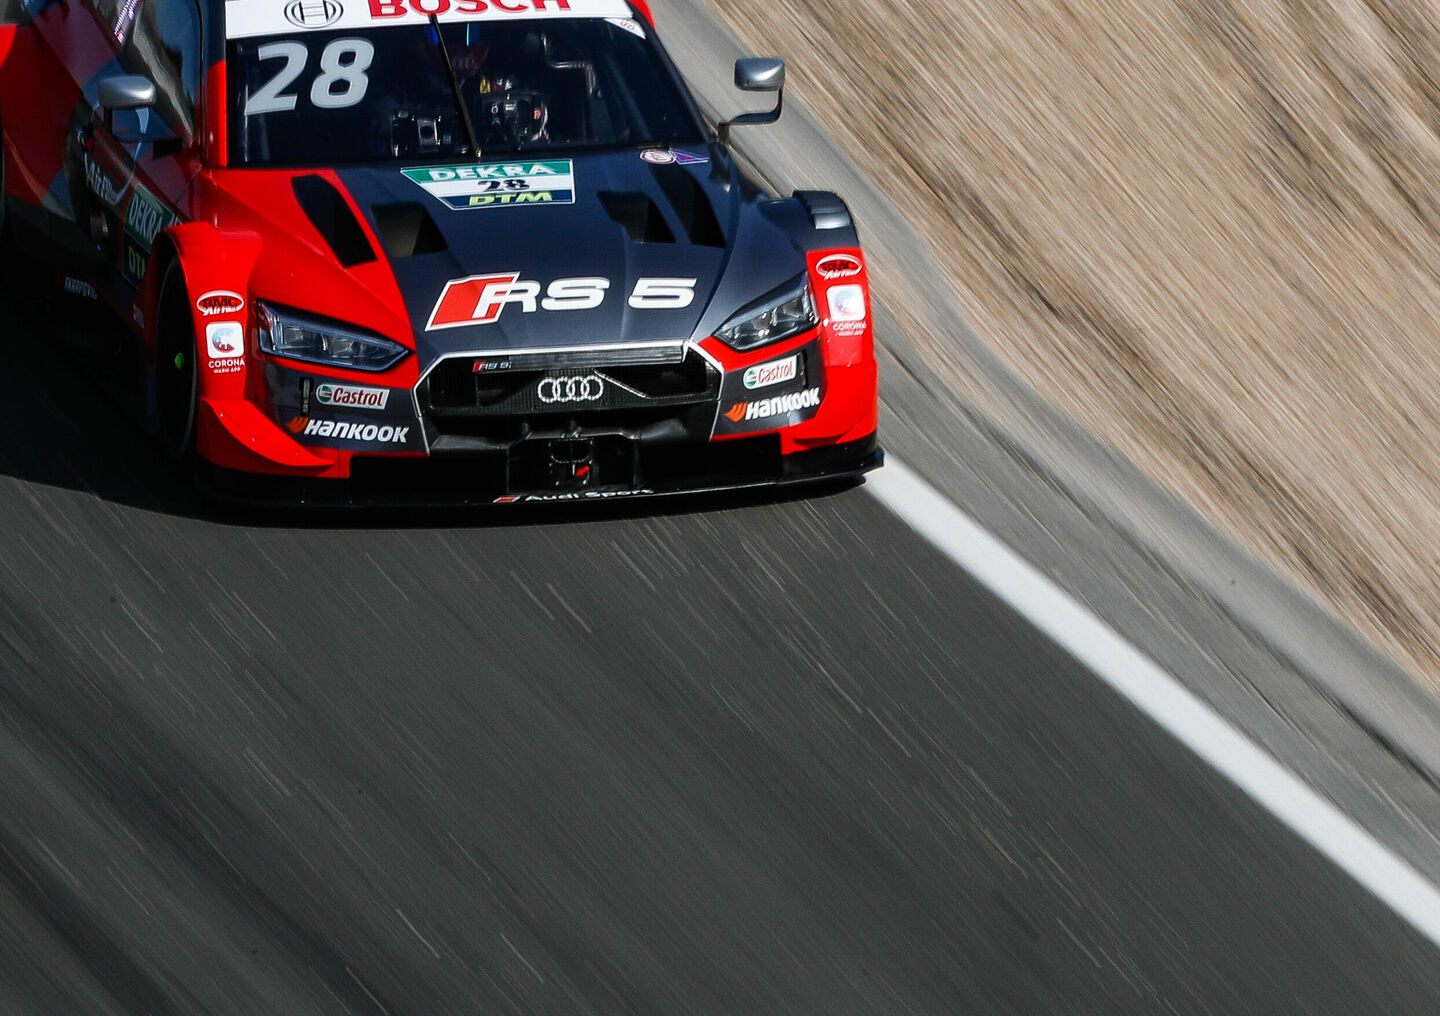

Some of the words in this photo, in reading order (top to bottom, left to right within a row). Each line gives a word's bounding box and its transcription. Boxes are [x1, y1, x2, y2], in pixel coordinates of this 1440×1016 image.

[244, 37, 375, 116] 28
[428, 163, 557, 181] DEKRA
[477, 179, 530, 192] 28
[468, 191, 553, 206] DTM
[471, 276, 610, 319] RS
[628, 277, 697, 309] 5
[208, 358, 246, 368] CORONA
[758, 360, 793, 384] Castrol
[333, 388, 384, 406] Castrol
